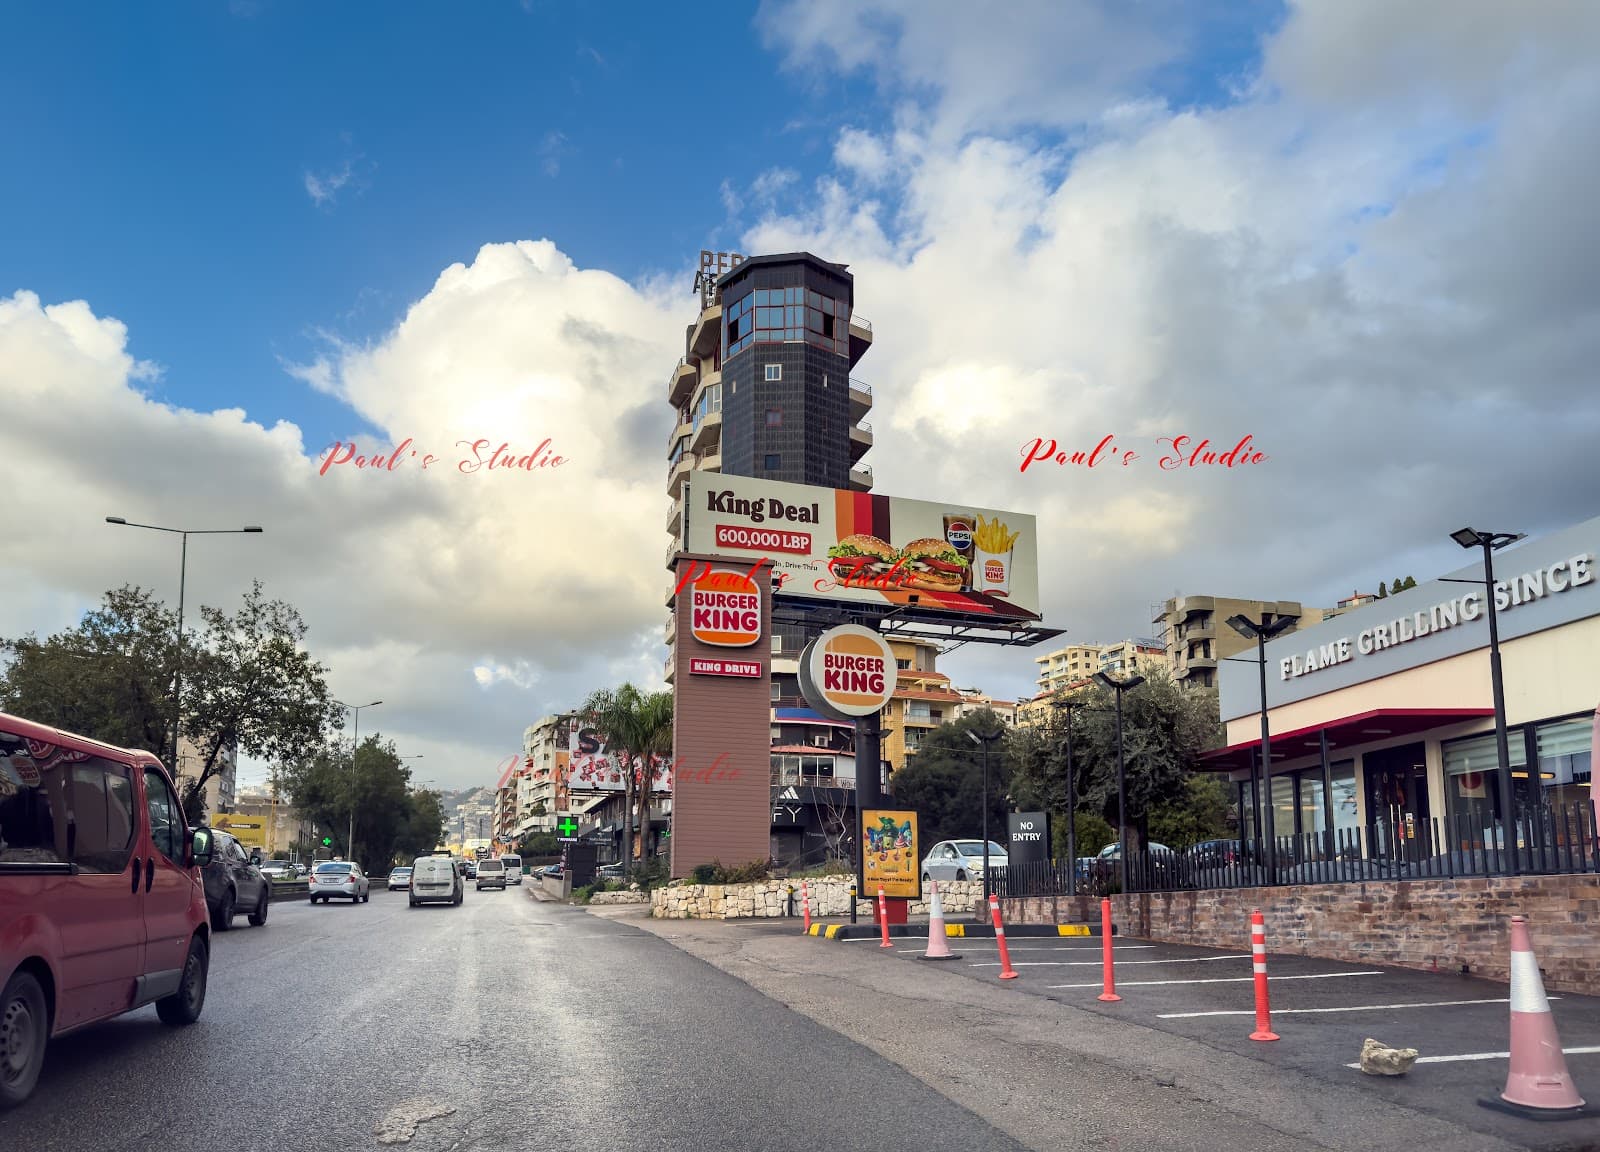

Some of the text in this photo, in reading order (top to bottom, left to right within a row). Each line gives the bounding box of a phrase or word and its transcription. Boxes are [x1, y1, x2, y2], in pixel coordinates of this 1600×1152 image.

[707, 490, 819, 524] King Deal
[719, 528, 809, 549] 600,000 LBP
[949, 531, 971, 540] PEPSI
[985, 571, 1004, 580] KING
[694, 592, 758, 609] BURGER
[693, 608, 759, 632] KING
[1280, 553, 1591, 681] FLAME GRILLING SINCE
[694, 661, 757, 674] KING DRIVE
[824, 653, 885, 673] BURGER
[824, 669, 885, 694] KING
[773, 806, 803, 823] FY
[1020, 821, 1034, 830] NO
[1012, 832, 1041, 841] ENTRY
